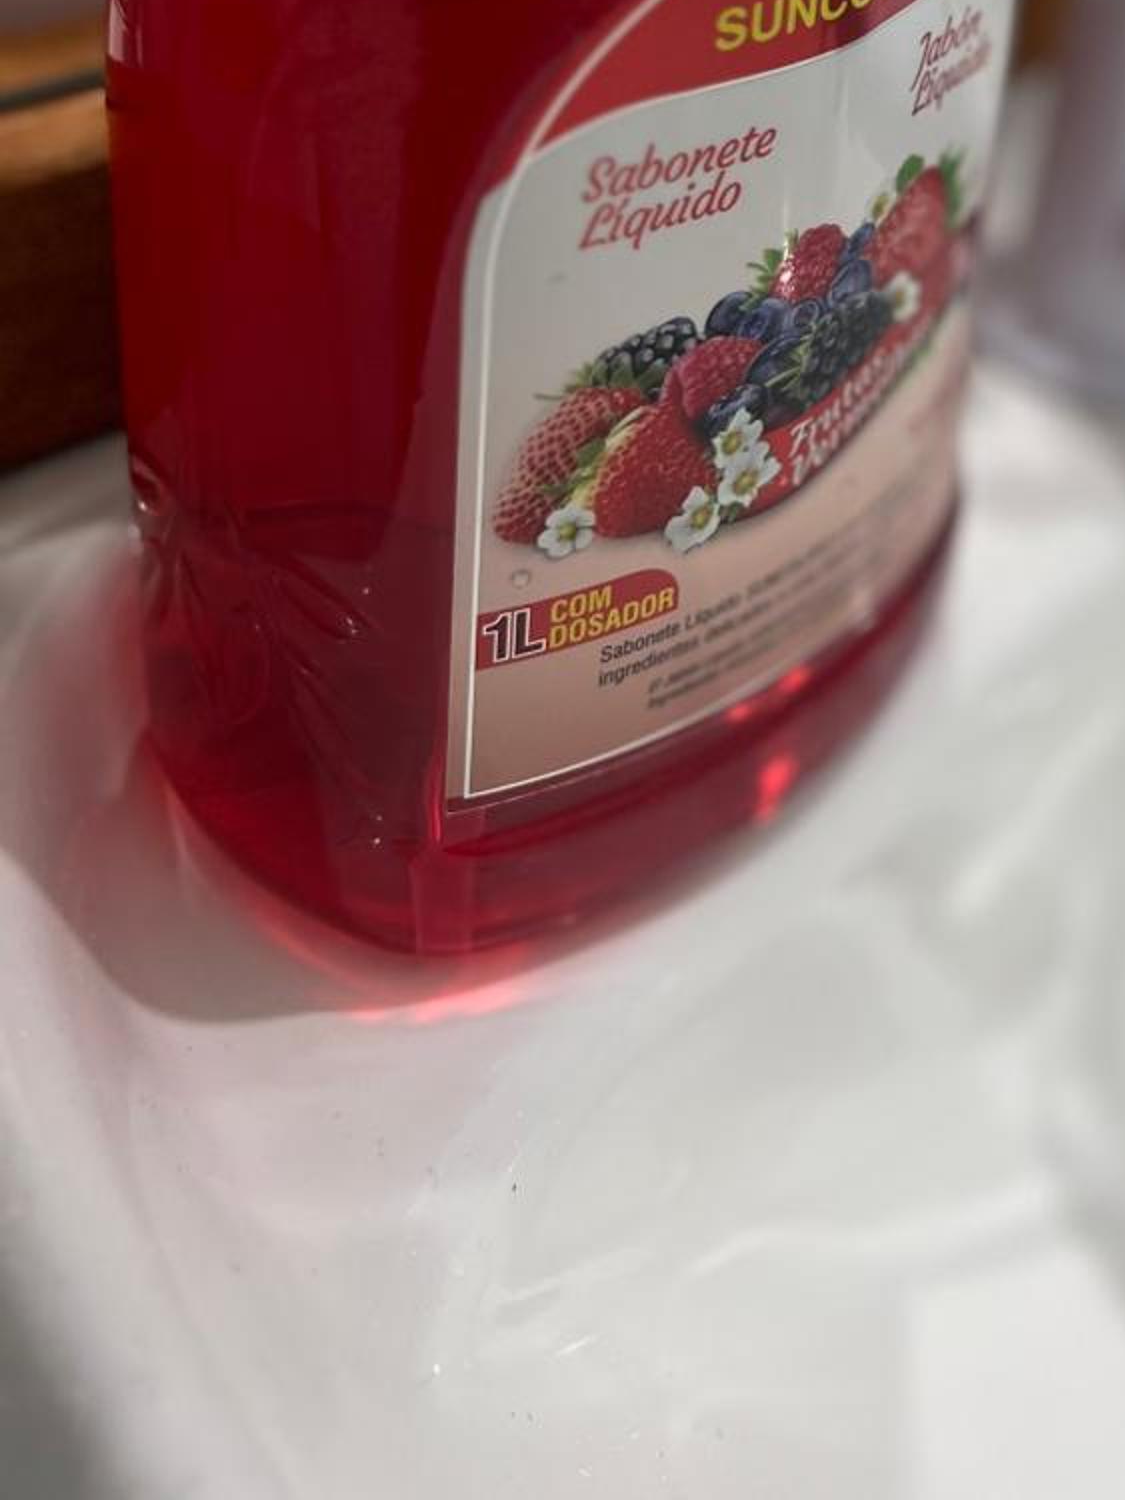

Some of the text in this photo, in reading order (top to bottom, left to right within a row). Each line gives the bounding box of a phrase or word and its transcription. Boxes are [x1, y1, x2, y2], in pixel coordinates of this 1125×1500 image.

[580, 126, 777, 204] Sabonete
[579, 171, 742, 251] Líquido
[549, 587, 675, 649] DOSADOR
[551, 585, 613, 623] COM
[482, 607, 547, 665] 1L
[600, 620, 681, 663] Sabonete
